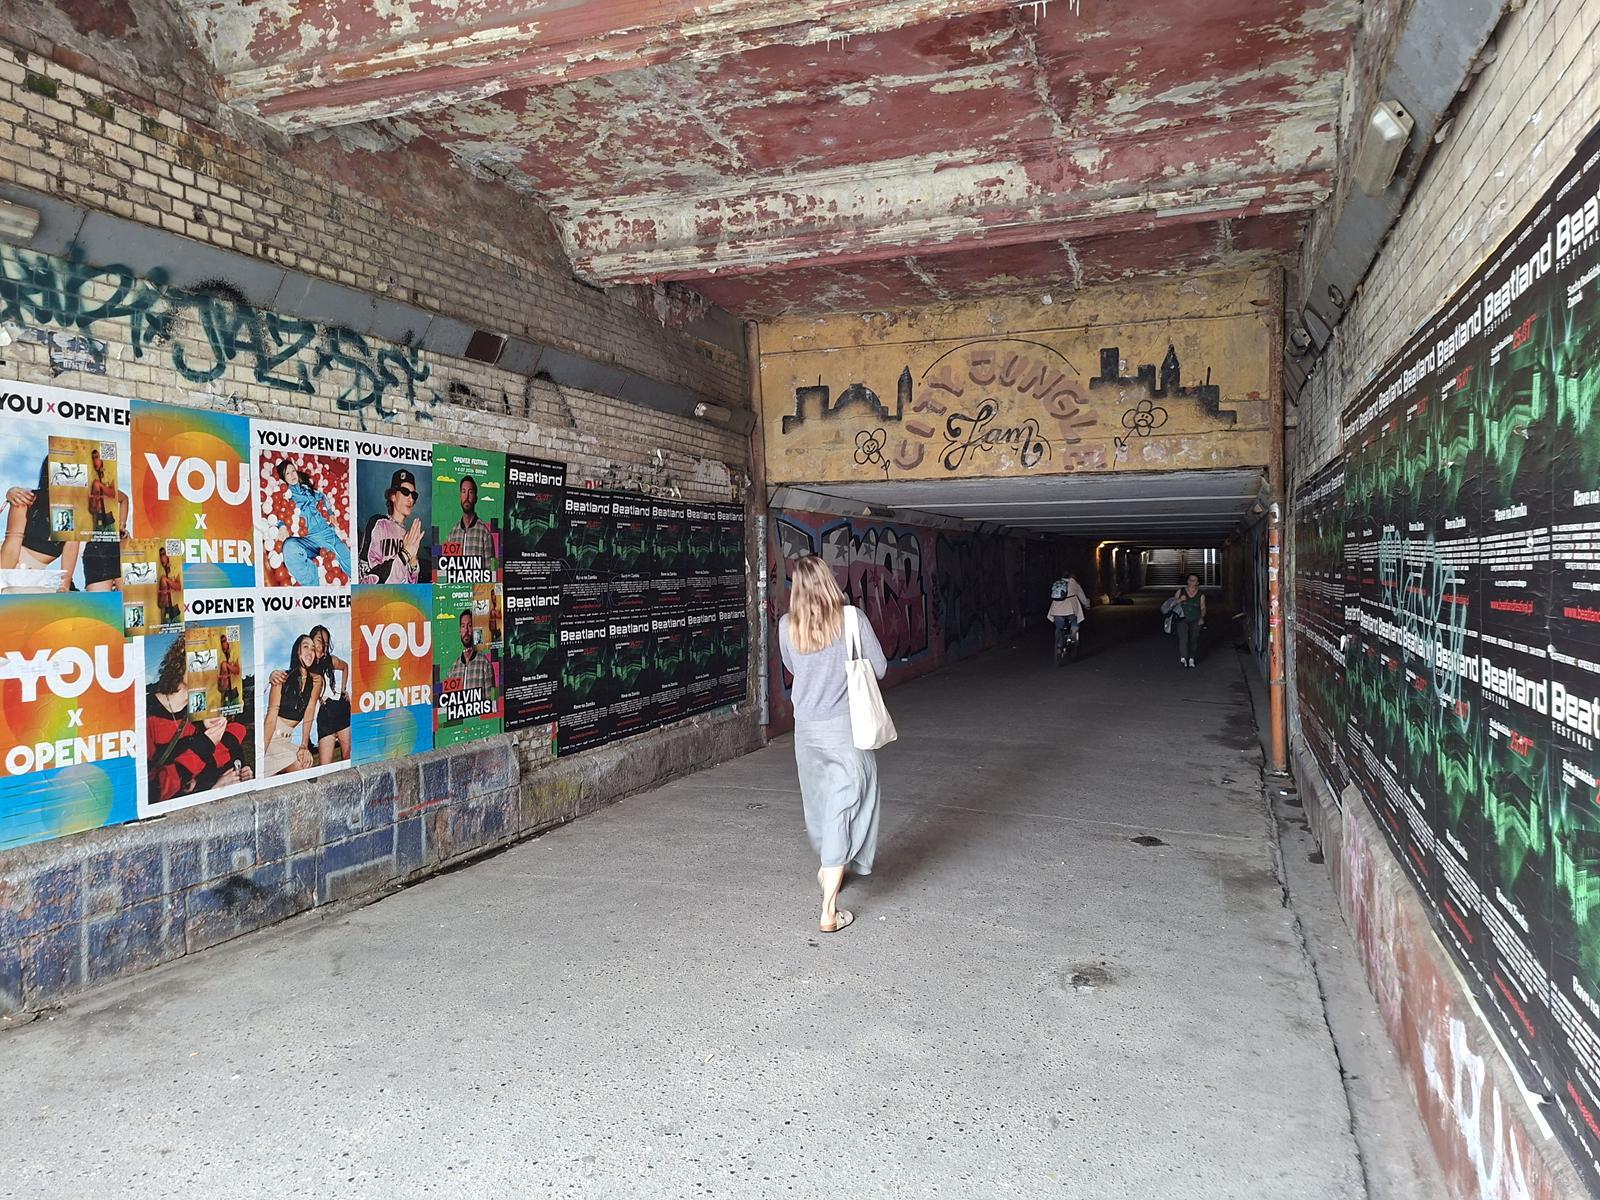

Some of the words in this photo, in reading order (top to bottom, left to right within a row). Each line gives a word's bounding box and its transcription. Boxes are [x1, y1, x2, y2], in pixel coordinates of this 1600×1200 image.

[1556, 183, 1600, 260] Bea
[1555, 230, 1600, 274] FESTIVAL
[1484, 232, 1552, 328] Beatland
[1437, 303, 1481, 368] Beatland
[1403, 346, 1435, 392] Beatland
[0, 393, 43, 415] YOU
[895, 366, 964, 470] CITY
[257, 430, 289, 447] YOU
[355, 441, 382, 457] YOU
[944, 402, 1044, 471] Jam
[144, 453, 250, 506] YOU
[509, 468, 563, 486] Beatland
[565, 499, 610, 514] Beatland
[612, 503, 650, 517] Beatland
[652, 506, 685, 519] Beatland
[686, 509, 716, 521] Beatland
[717, 511, 743, 521] Beatland
[1574, 490, 1590, 506] Rave
[180, 539, 253, 566] EN'ER
[439, 556, 481, 570] CALVIN
[448, 570, 491, 583] HARRIS
[192, 598, 254, 614] OPEN'ER
[262, 597, 293, 611] YOU
[507, 594, 560, 609] Beatland
[560, 627, 606, 641] Beatland
[609, 622, 649, 635] Beatland
[652, 617, 686, 630] Beatland
[688, 613, 716, 625] Beatland
[719, 610, 745, 620] Beatland
[360, 621, 431, 661] YOU
[6, 643, 136, 702] YOU
[1436, 641, 1478, 683] Beatland
[1482, 657, 1548, 715] Beatland
[359, 685, 432, 713] OPEN'ER
[439, 688, 481, 707] CALVIN
[448, 700, 491, 720] HARRIS
[1552, 721, 1593, 751] FESTIVAL
[5, 730, 137, 775] OPEN'ER
[1573, 975, 1590, 1007] Rave
[1590, 998, 1600, 1019] na
